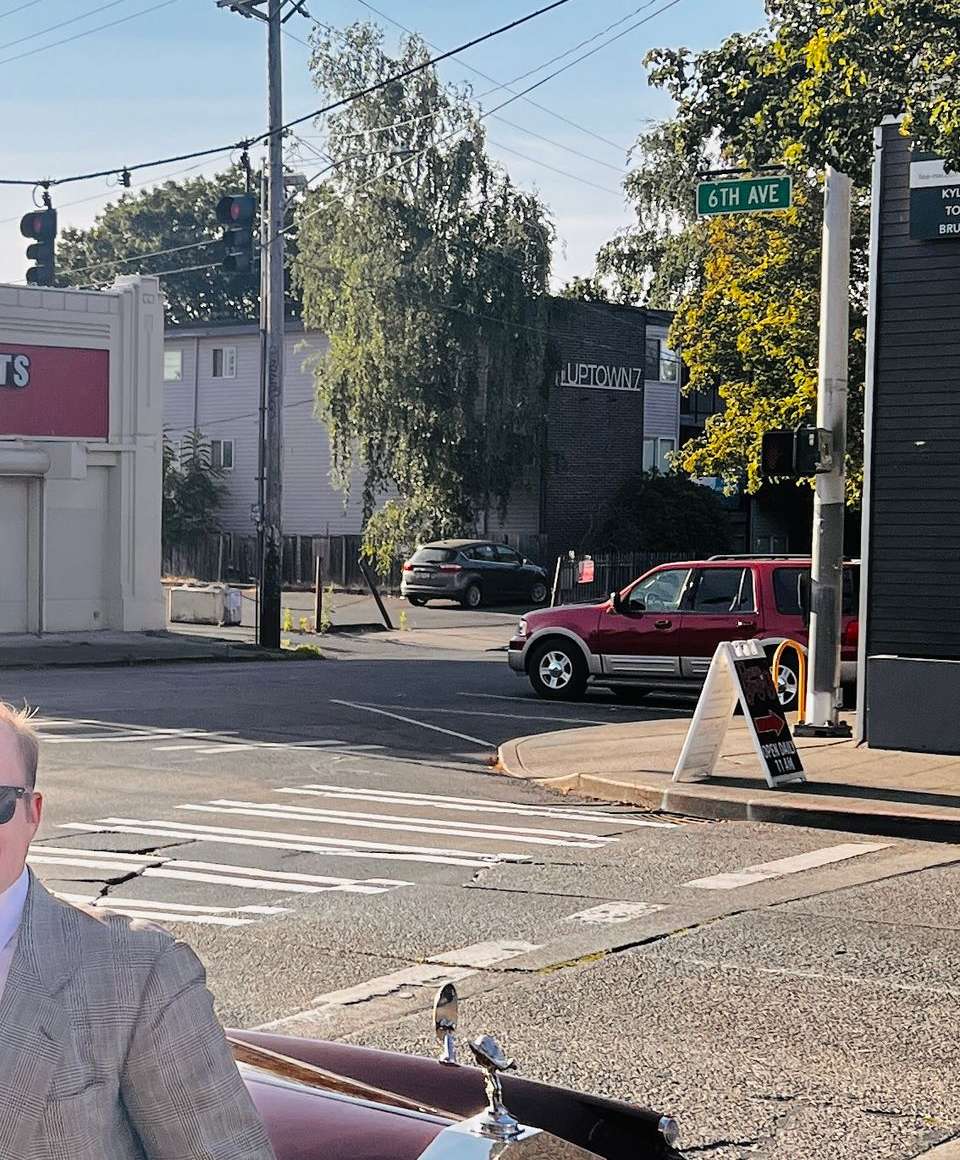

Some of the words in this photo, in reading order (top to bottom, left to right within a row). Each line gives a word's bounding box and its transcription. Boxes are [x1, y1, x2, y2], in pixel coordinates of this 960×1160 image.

[708, 187, 740, 208] 6TH
[747, 184, 780, 205] AVE
[761, 743, 781, 758] OPEN
